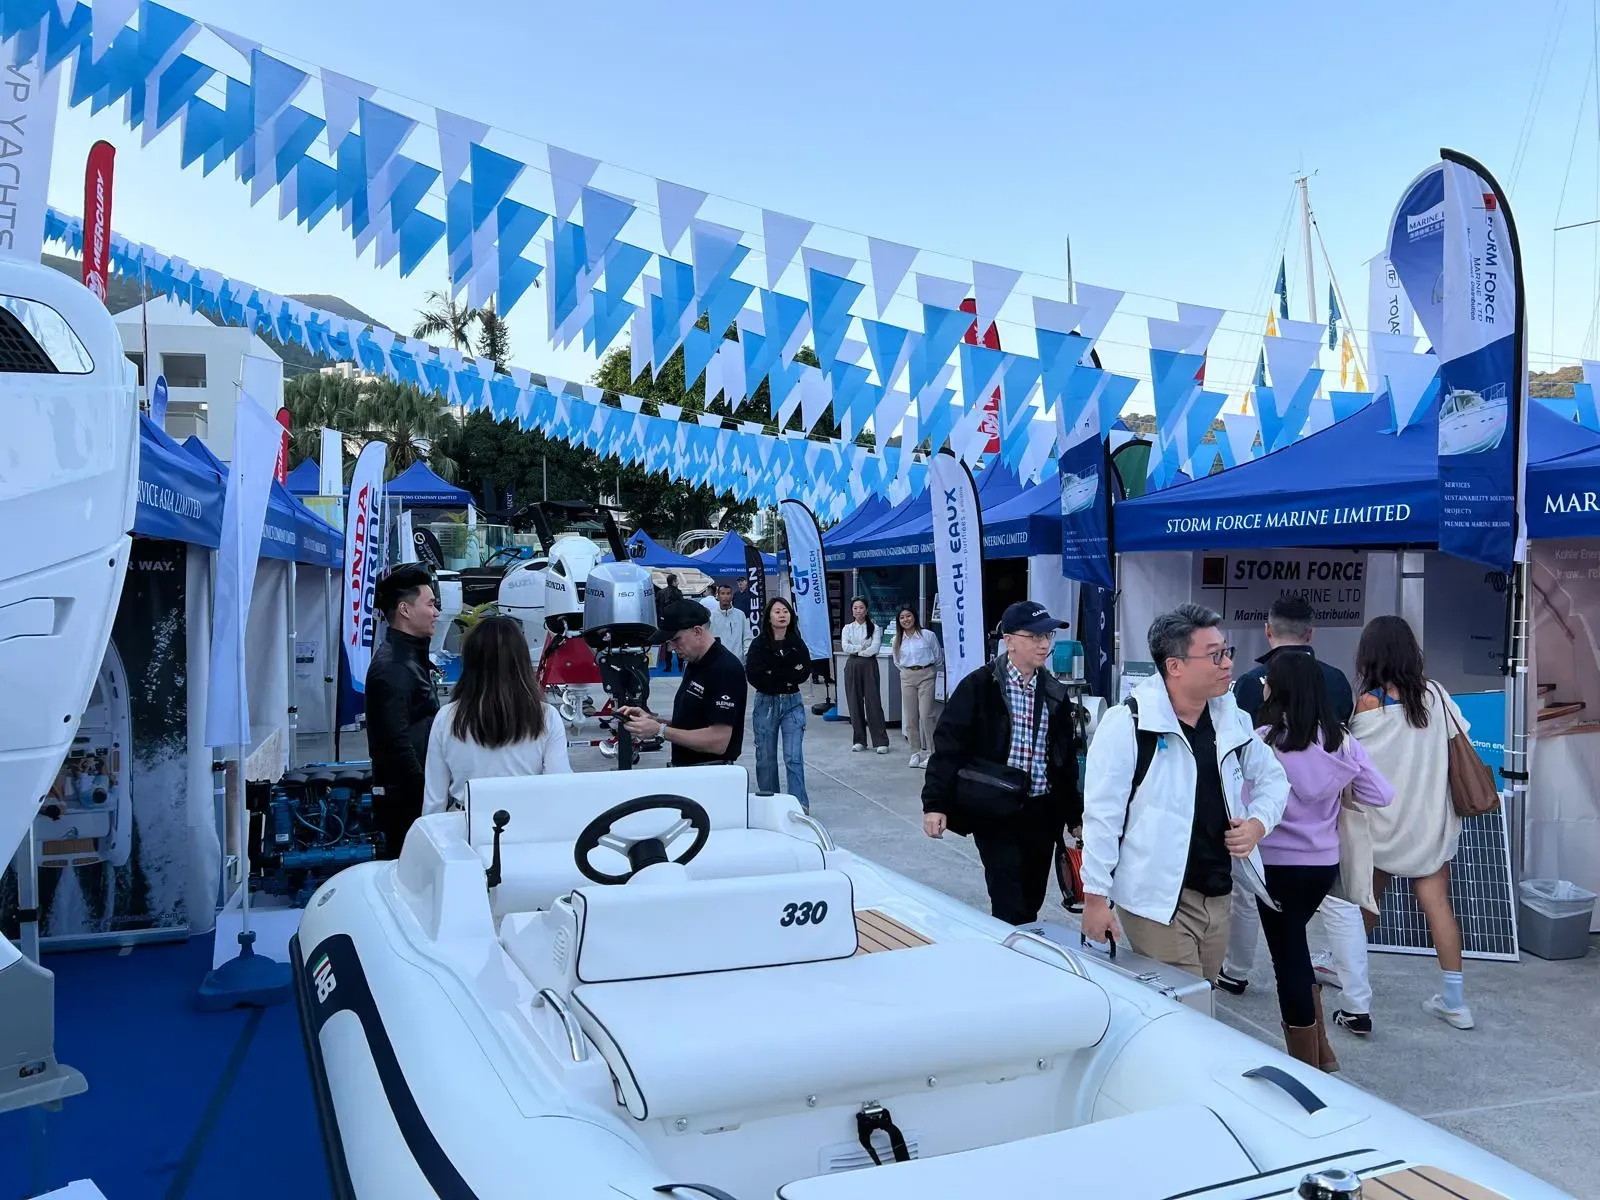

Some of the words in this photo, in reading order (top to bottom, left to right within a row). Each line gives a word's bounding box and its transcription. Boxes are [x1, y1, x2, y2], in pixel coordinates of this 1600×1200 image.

[94, 169, 104, 270] MERCURY
[1485, 272, 1496, 324] FORCE
[137, 480, 159, 508] RVICE
[175, 493, 202, 519] LIMITED
[1544, 492, 1600, 514] MAR
[944, 487, 962, 554] EAUX
[1166, 516, 1212, 534] STORM
[1215, 513, 1262, 531] FORCE
[1265, 509, 1329, 528] MARINE
[1333, 503, 1411, 525] LIMITED
[983, 534, 1005, 548] NEERING
[1006, 531, 1028, 545] LIMITED
[138, 560, 175, 571] WAY.
[351, 483, 368, 646] HONDA
[810, 550, 821, 605] GRANDTECH
[1234, 560, 1301, 581] STORM
[1307, 562, 1363, 581] FORCE
[749, 567, 760, 638] OCEAN
[1280, 588, 1331, 602] MARINE
[1338, 589, 1361, 602] LTD
[1234, 610, 1268, 621] Marine
[1471, 740, 1491, 749] ctron
[780, 900, 828, 927] 330
